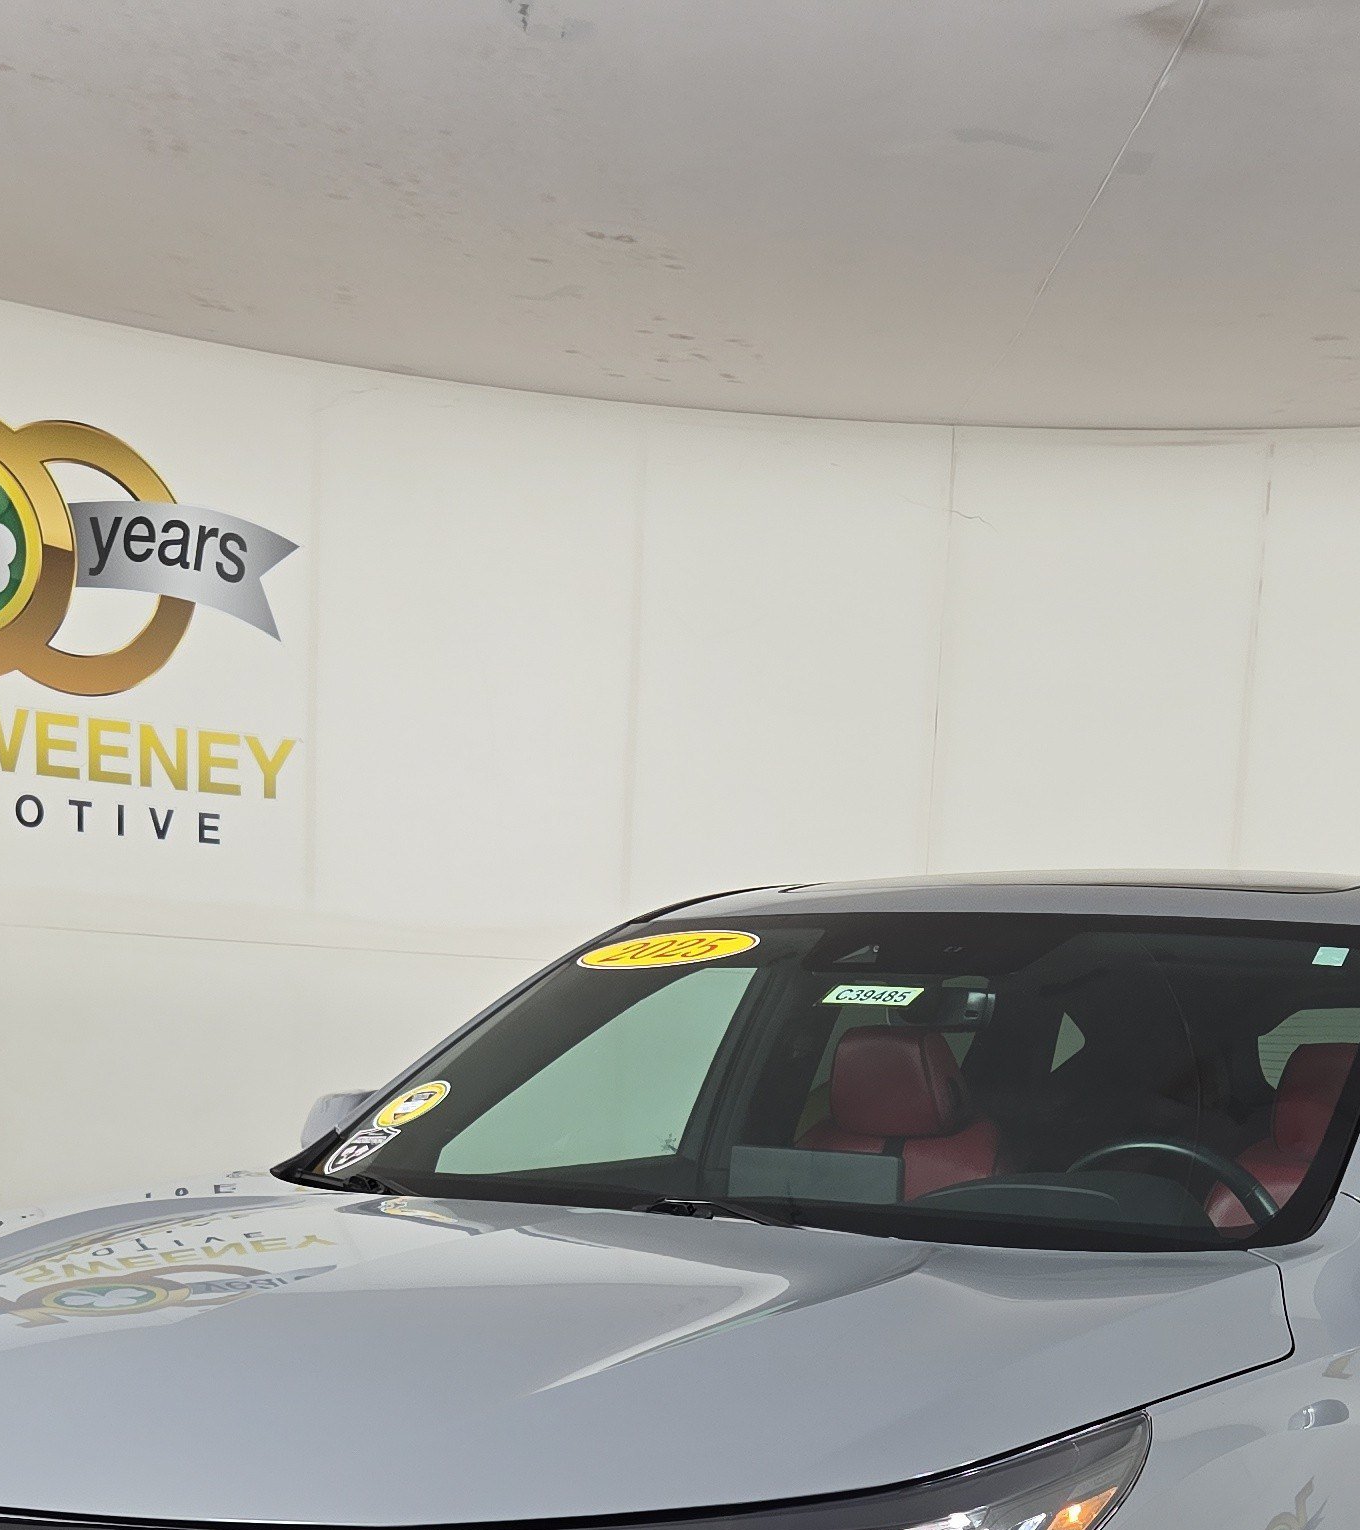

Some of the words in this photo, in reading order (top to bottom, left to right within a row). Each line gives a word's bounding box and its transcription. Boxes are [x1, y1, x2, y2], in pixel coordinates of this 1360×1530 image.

[87, 514, 248, 583] years
[597, 937, 738, 963] 2025
[835, 988, 912, 1003] C39485
